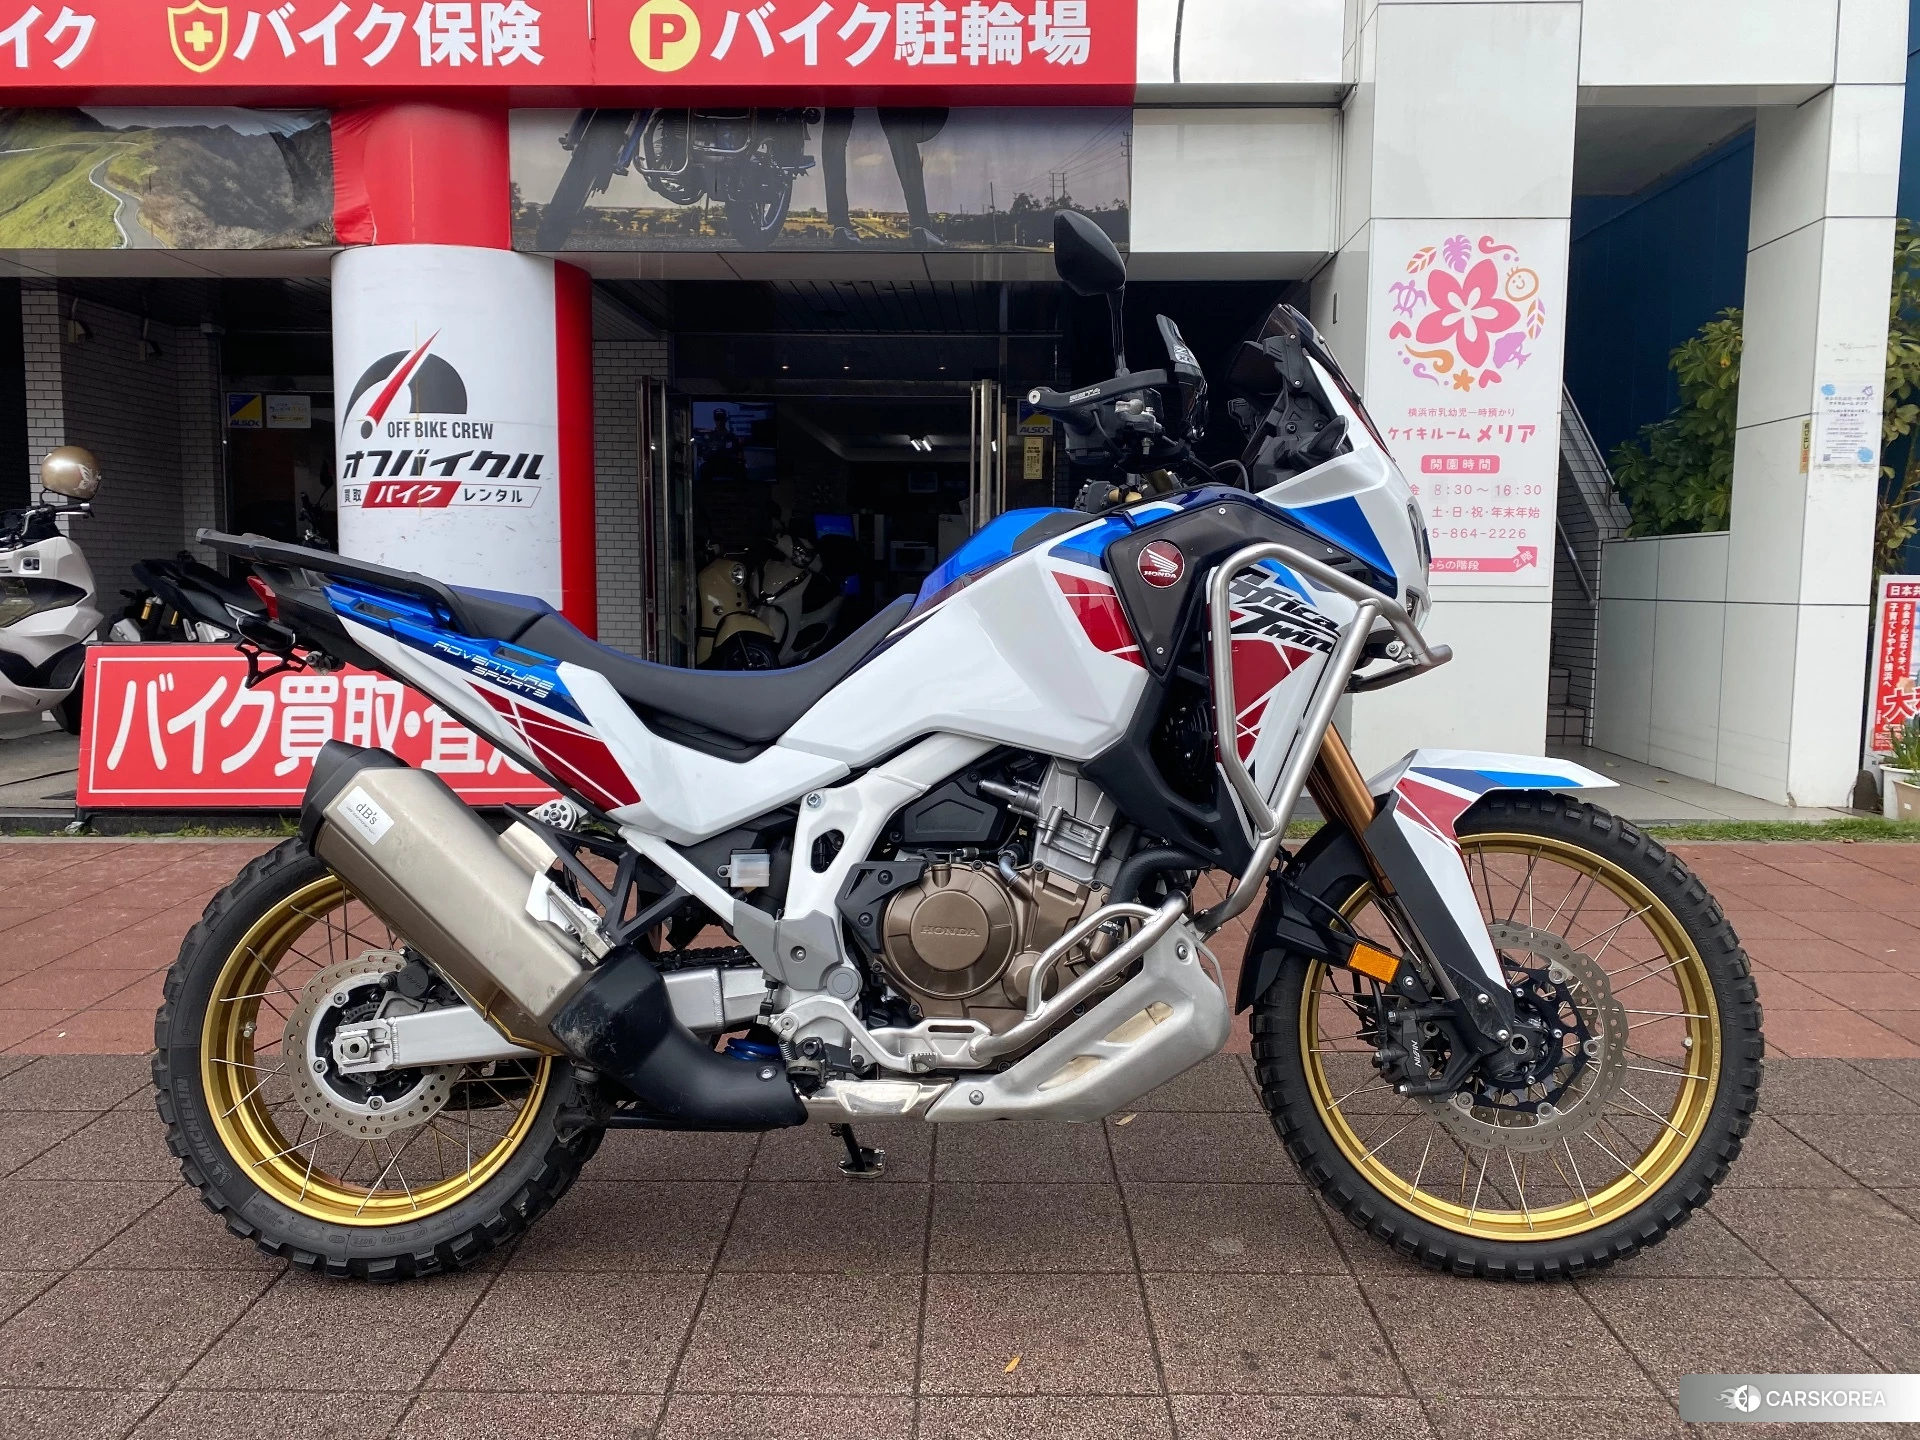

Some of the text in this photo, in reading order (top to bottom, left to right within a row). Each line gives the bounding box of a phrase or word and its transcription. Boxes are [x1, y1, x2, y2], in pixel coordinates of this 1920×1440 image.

[234, 0, 544, 66] バイク保険
[711, 0, 1091, 66] バイク駐輪場
[1408, 407, 1516, 418] 横浜市乳幼児一時預かり
[387, 421, 494, 440] OFF BIKE CREW
[1019, 426, 1051, 434] ALSOK
[1388, 424, 1536, 443] ケイキルーム メリア
[342, 449, 545, 480] オフバイクル
[1430, 458, 1491, 471] 開園時間
[374, 484, 442, 504] バイク
[464, 488, 523, 503] レンタル
[1427, 528, 1527, 540] 5-864-2226
[1143, 570, 1178, 579] HONDA
[433, 640, 556, 691] ADVENTURE
[472, 665, 549, 699] SPORTS
[920, 925, 981, 938] HONDA
[1410, 1039, 1422, 1068] NISSIN
[177, 1078, 217, 1165] MICHELIN
